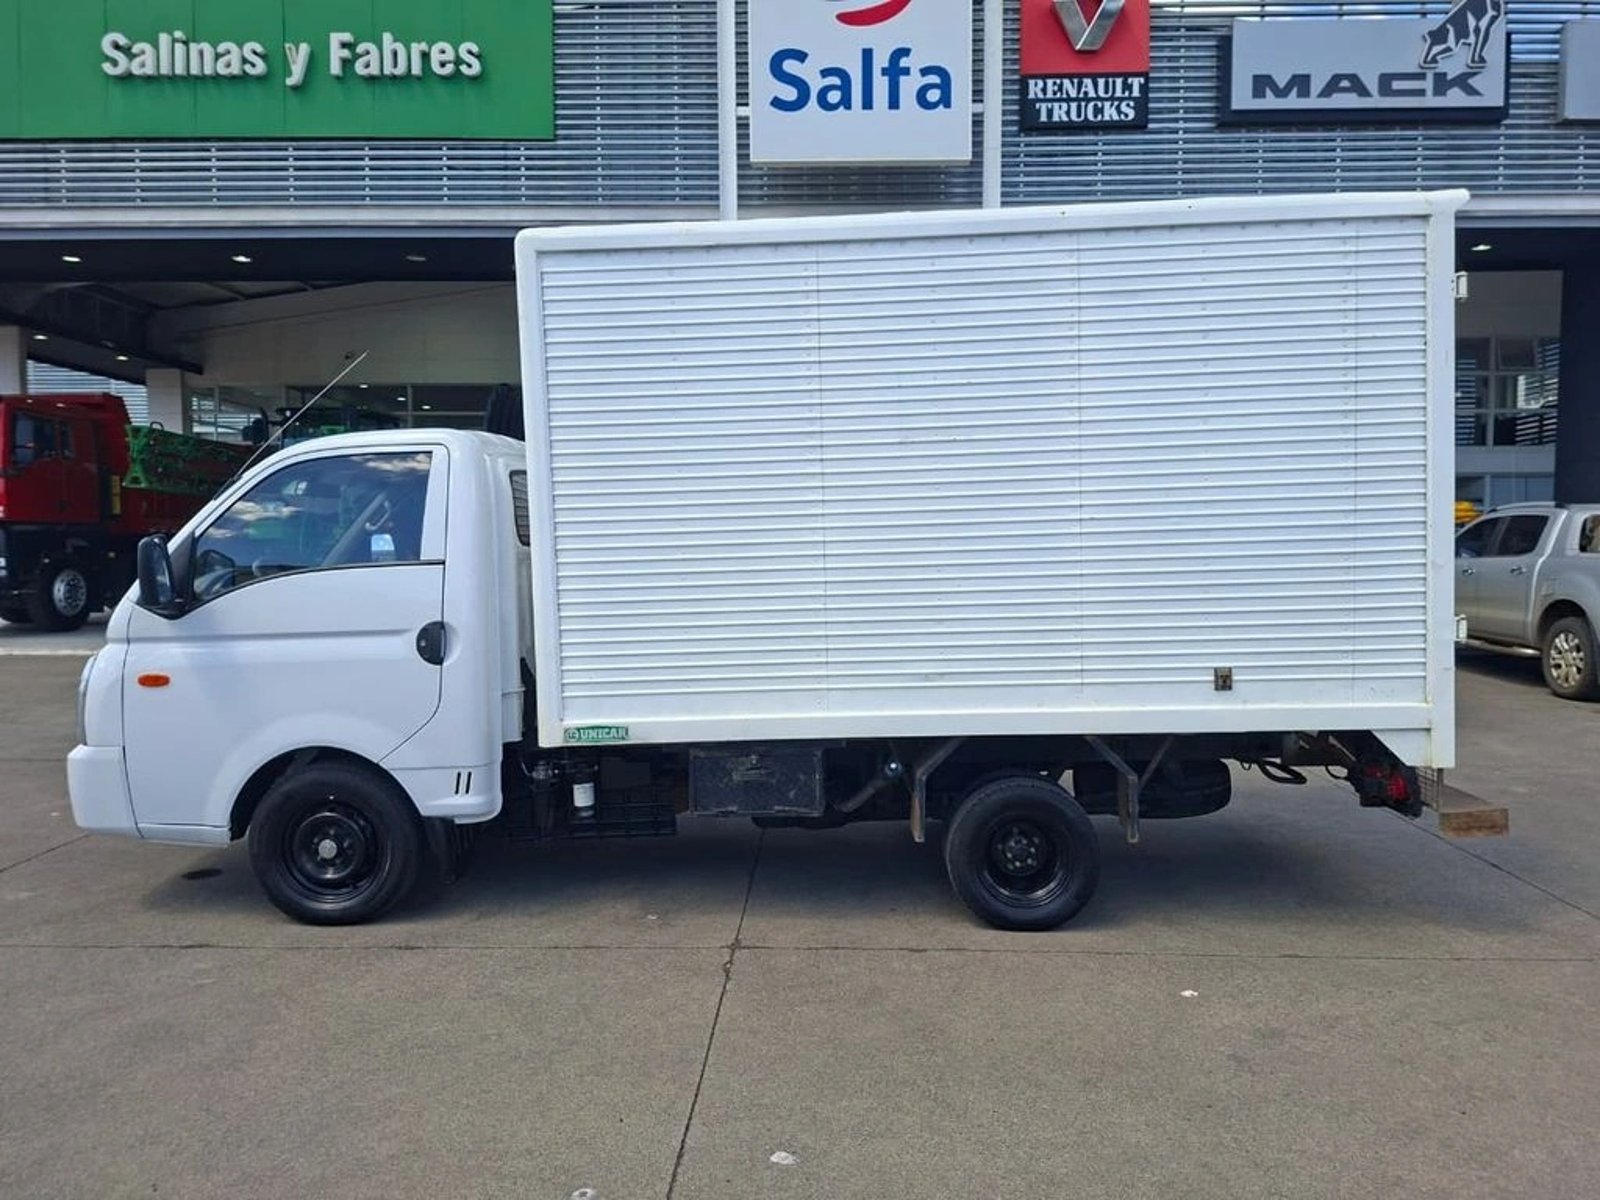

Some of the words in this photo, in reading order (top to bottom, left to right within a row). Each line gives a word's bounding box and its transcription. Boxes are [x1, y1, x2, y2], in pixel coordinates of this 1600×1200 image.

[101, 31, 267, 78] Salinas
[285, 41, 310, 87] y
[329, 32, 482, 77] Fabres
[769, 47, 952, 112] Salfa
[1027, 77, 1144, 98] RENAULT
[1251, 71, 1484, 99] MACK
[1035, 100, 1135, 122] TRUCKS
